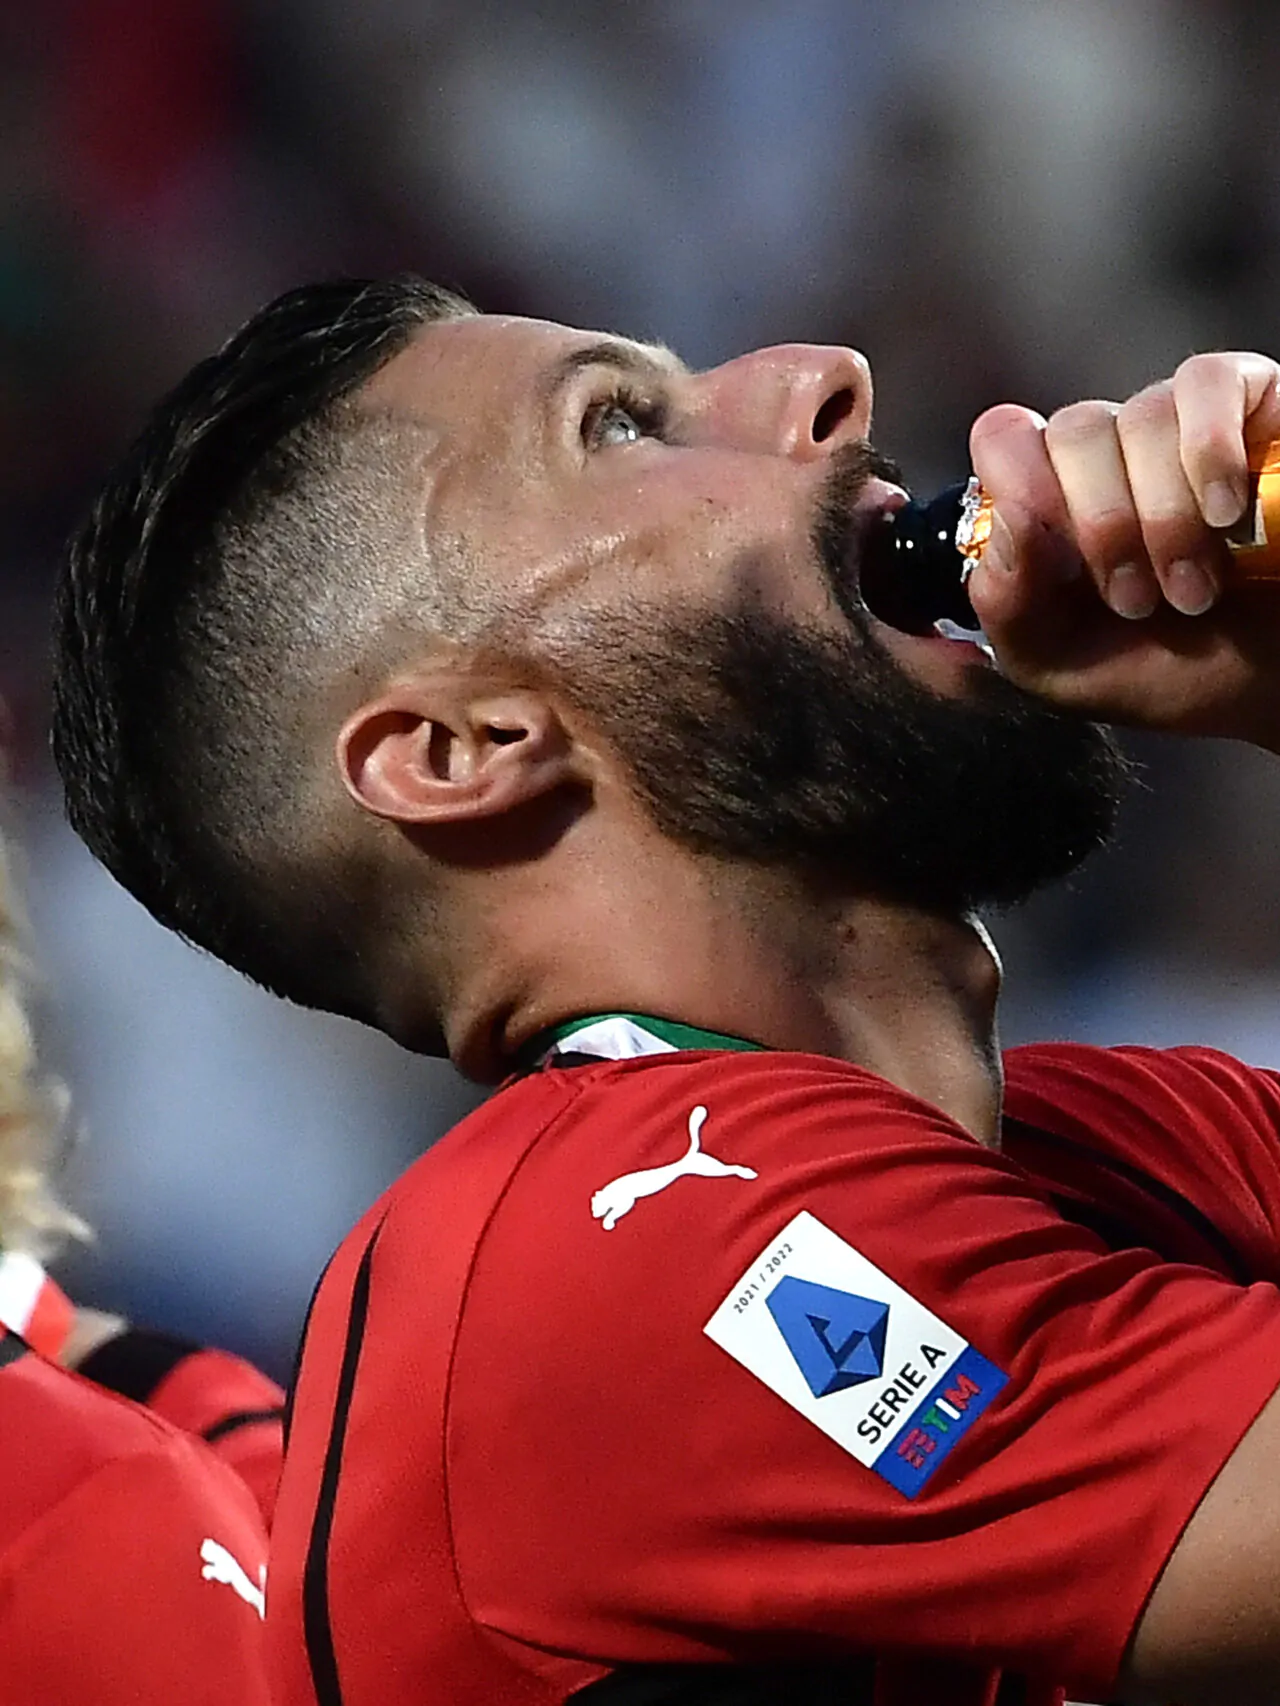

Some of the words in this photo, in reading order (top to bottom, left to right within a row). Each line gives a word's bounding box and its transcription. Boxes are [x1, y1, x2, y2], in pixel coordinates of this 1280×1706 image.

[733, 1284, 760, 1314] 2021
[765, 1243, 794, 1272] 2022
[857, 1363, 927, 1444] SERIE
[920, 1344, 946, 1368] A
[923, 1373, 981, 1433] TIM
